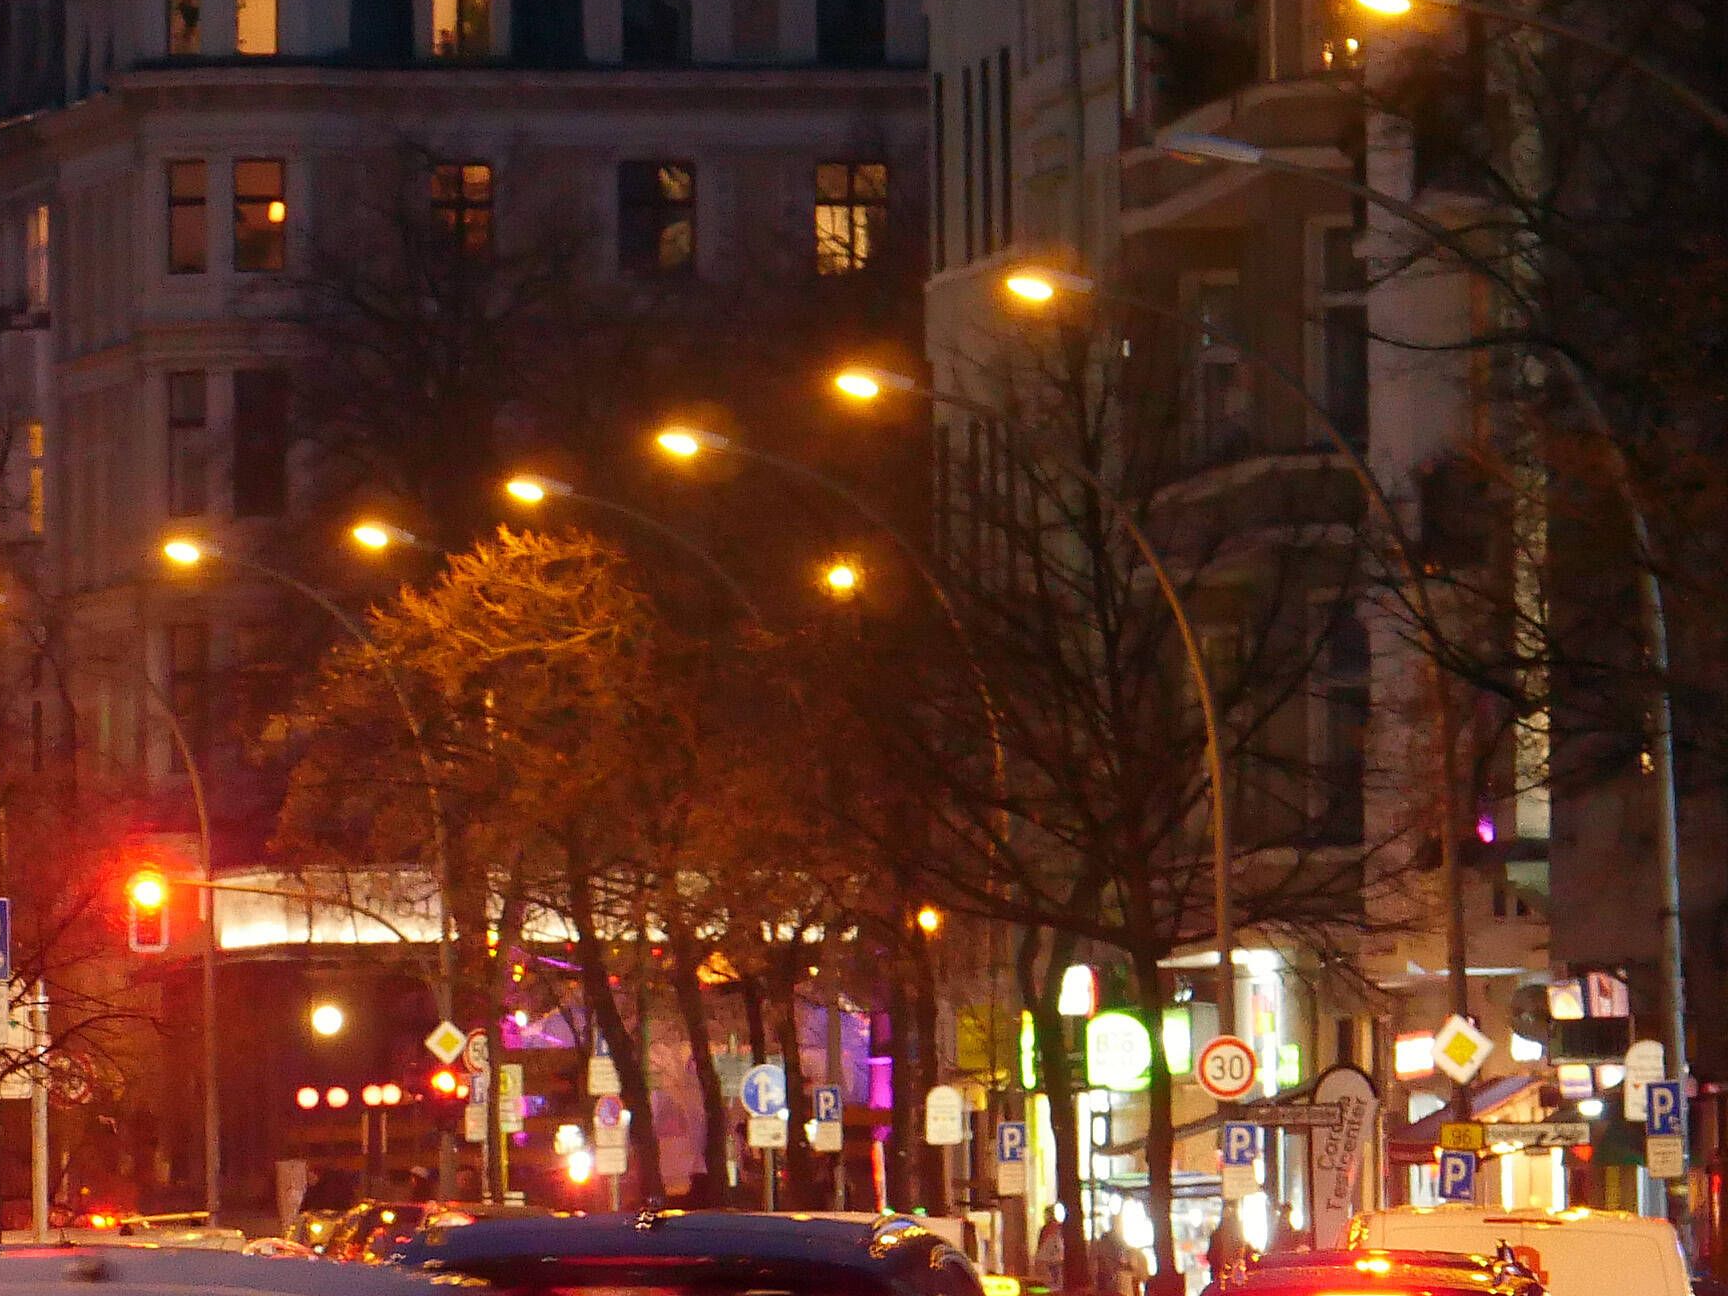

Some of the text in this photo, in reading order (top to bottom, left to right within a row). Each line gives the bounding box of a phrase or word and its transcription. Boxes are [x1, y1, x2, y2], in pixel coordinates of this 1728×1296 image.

[1211, 1056, 1244, 1080] 30
[1653, 1088, 1674, 1130] P
[1230, 1126, 1251, 1162] P
[1318, 1096, 1351, 1169] Coroa
[1446, 1158, 1466, 1193] P
